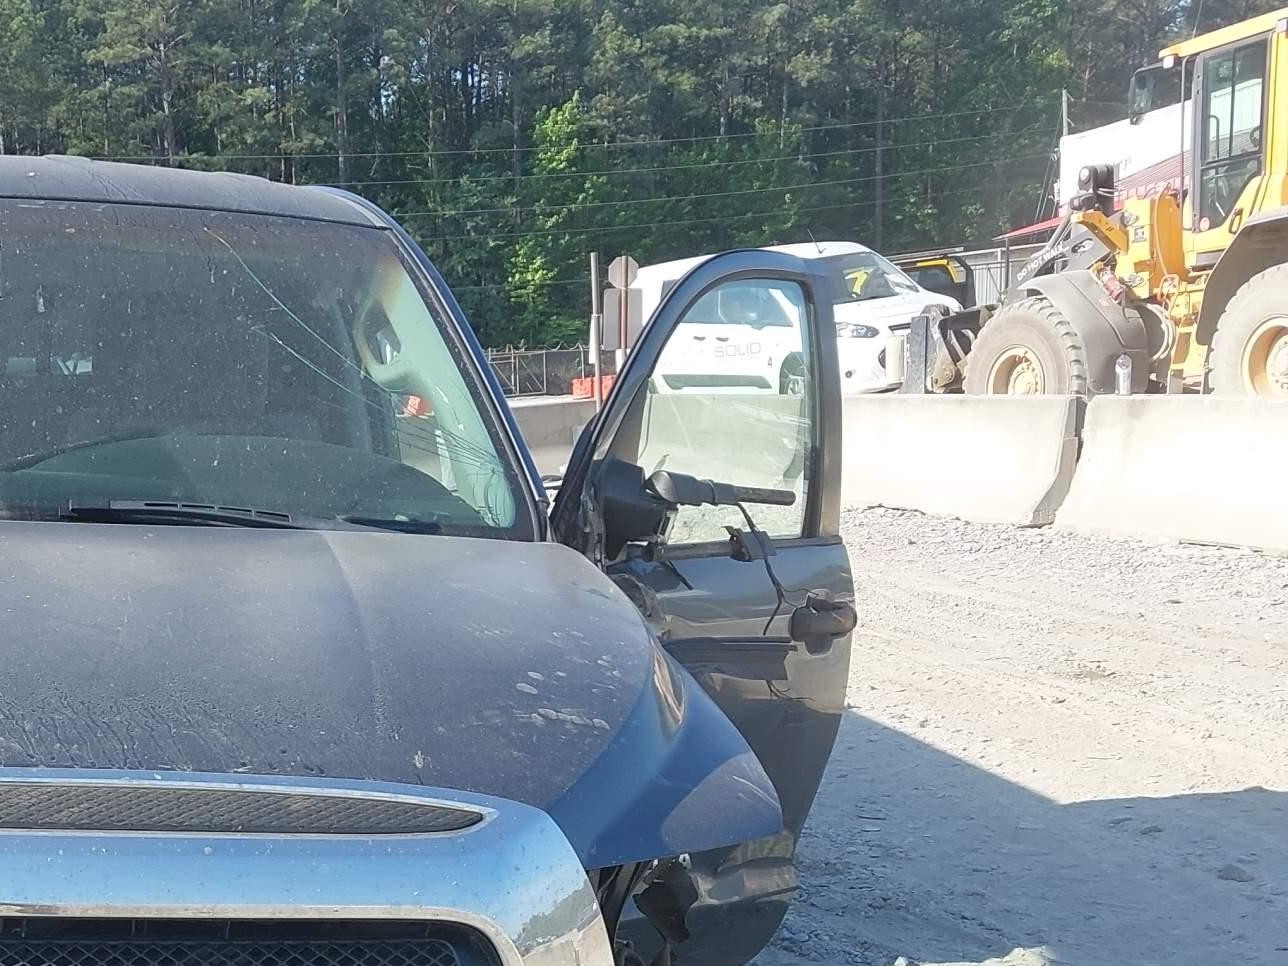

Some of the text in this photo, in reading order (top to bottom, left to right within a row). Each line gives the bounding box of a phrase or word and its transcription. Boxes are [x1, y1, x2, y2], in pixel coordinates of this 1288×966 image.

[1016, 269, 1027, 281] DO
[1027, 256, 1043, 272] NOT
[715, 343, 761, 358] SOLID
